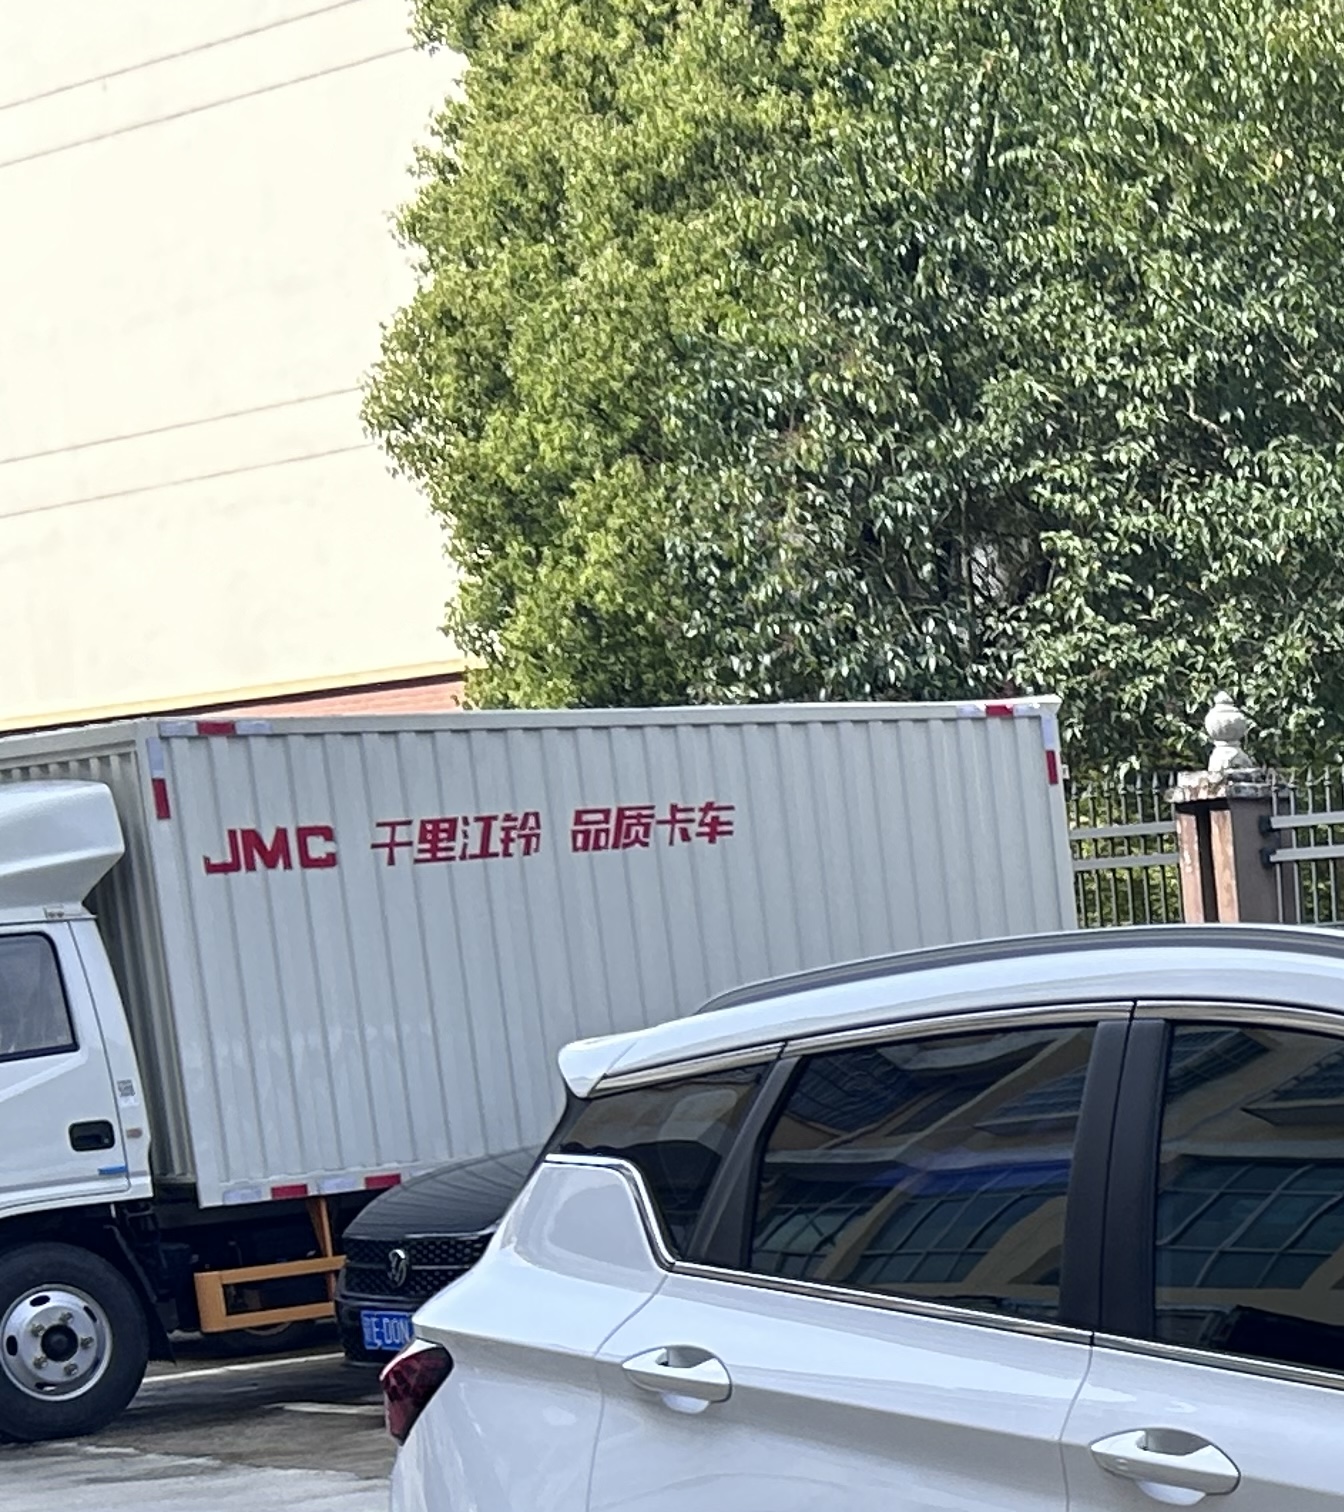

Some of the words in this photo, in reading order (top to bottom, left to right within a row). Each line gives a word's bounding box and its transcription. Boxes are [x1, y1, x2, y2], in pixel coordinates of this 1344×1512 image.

[203, 825, 337, 873] JMC
[371, 811, 541, 866] 千里江铃
[571, 802, 735, 852] 品质卡车
